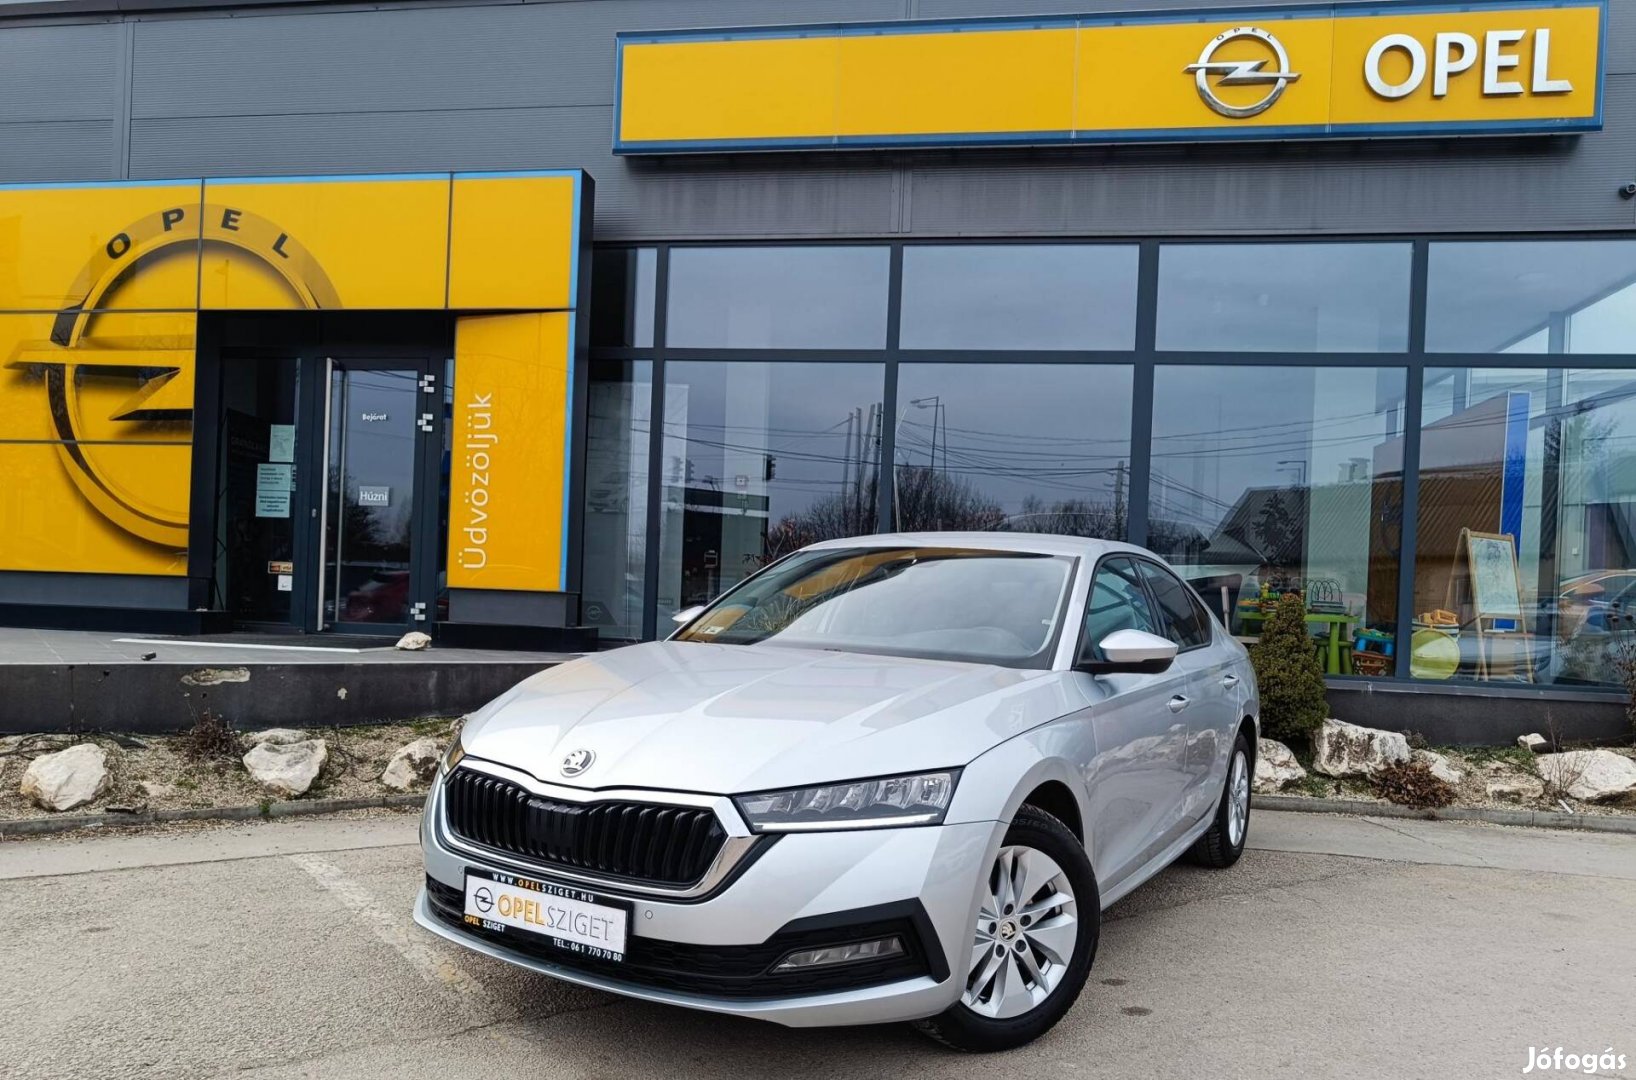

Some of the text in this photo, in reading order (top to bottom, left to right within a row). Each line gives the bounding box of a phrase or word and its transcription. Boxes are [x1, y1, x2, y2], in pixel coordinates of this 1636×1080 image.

[1217, 27, 1272, 41] OPEL
[1364, 28, 1573, 98] OPEL
[106, 208, 290, 260] OPEL
[362, 413, 387, 422] Bejárat
[458, 393, 498, 568] Üdvözöljük
[360, 489, 388, 501] Húzni
[492, 873, 594, 903] WWW.OPELSZIGET.HU
[464, 914, 506, 933] OPEL SZIGET
[588, 946, 601, 957] 770
[602, 950, 612, 960] 70
[612, 952, 622, 962] 80
